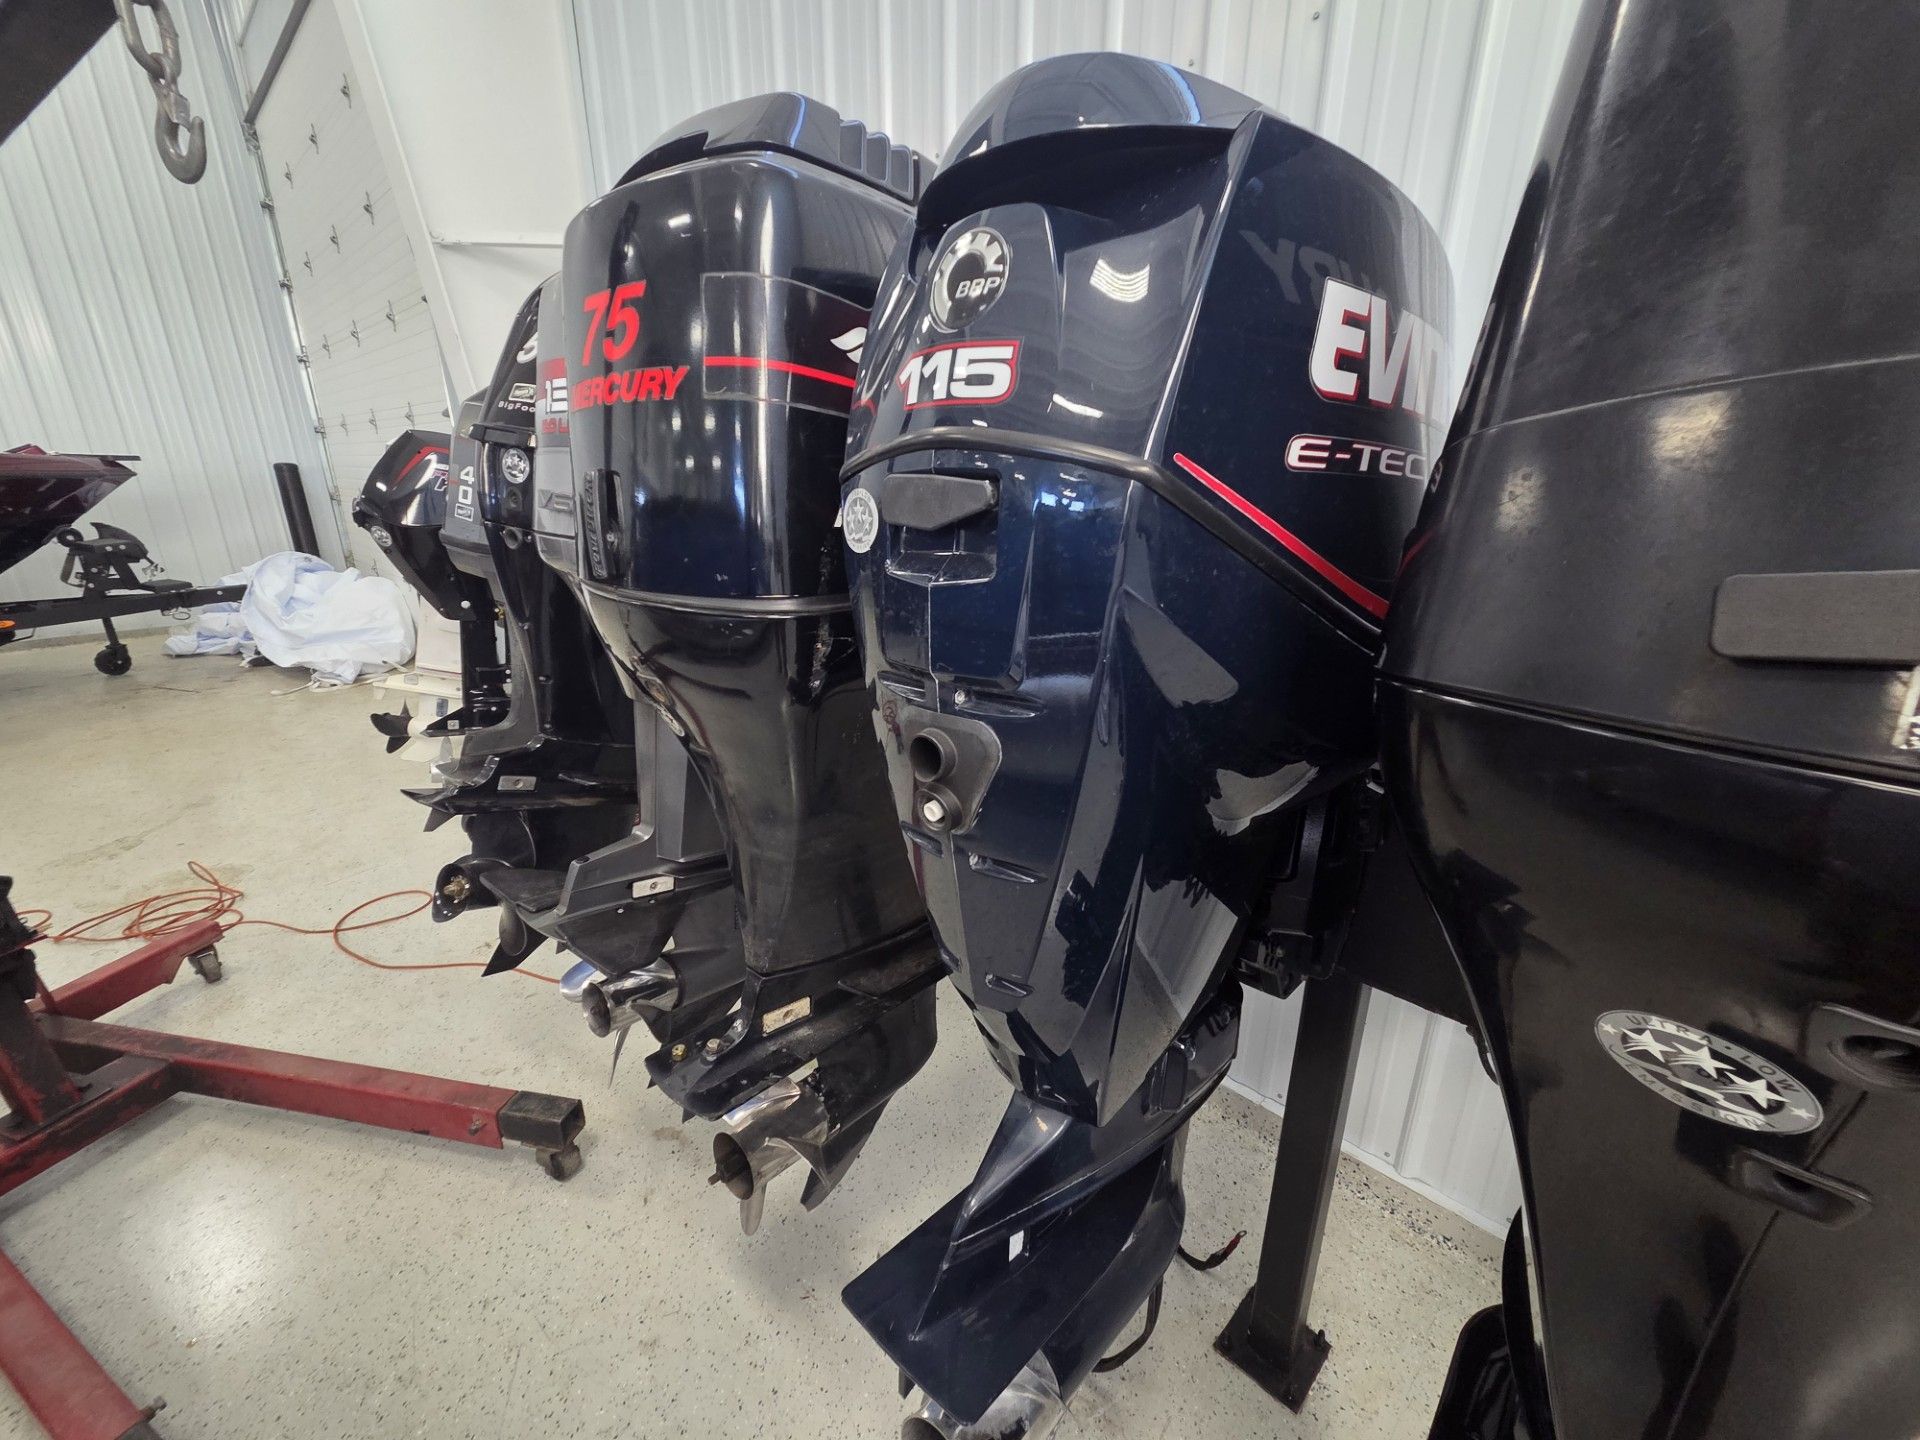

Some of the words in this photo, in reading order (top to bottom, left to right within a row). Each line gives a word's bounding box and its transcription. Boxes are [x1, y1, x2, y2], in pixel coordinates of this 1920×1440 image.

[581, 280, 646, 367] 75
[899, 345, 1015, 405] 115
[1740, 1055, 1801, 1093] LOW
